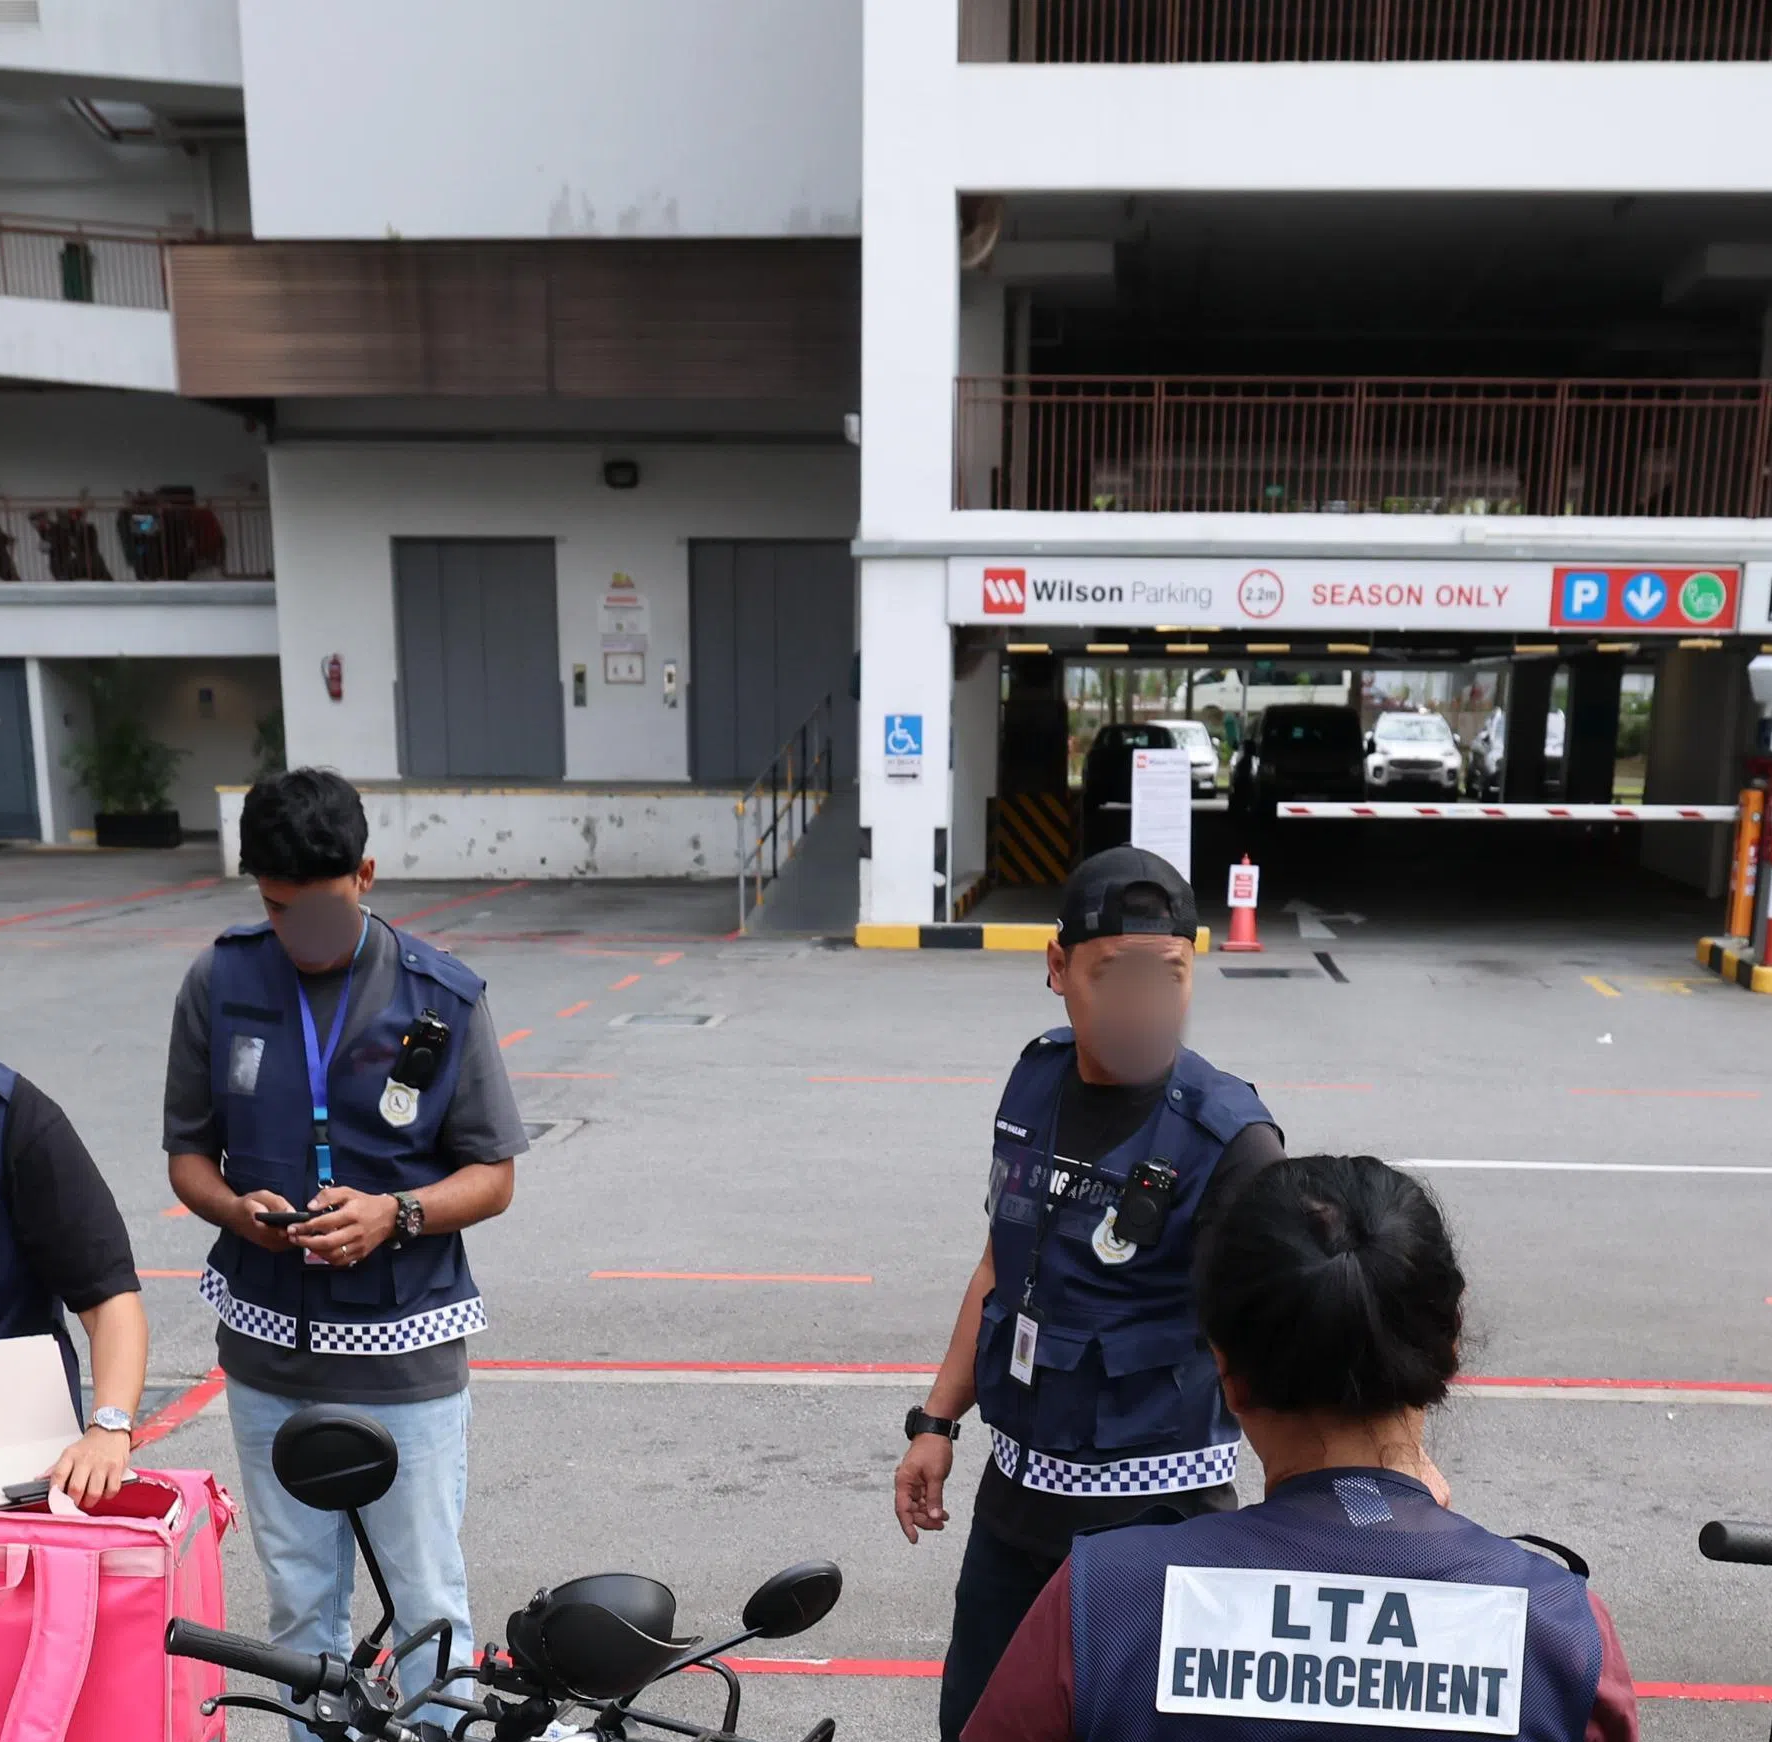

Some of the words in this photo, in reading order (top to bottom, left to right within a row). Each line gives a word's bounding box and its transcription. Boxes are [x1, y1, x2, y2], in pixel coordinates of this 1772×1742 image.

[1032, 579, 1123, 602] Wilson
[1131, 581, 1213, 609] Parking
[1245, 586, 1278, 602] 2.2m
[1311, 584, 1423, 606] SEASON
[1434, 585, 1509, 607] ONLY
[1571, 580, 1599, 613] P
[1271, 1583, 1418, 1648] LTA
[1171, 1646, 1508, 1717] ENFORCEMENT
